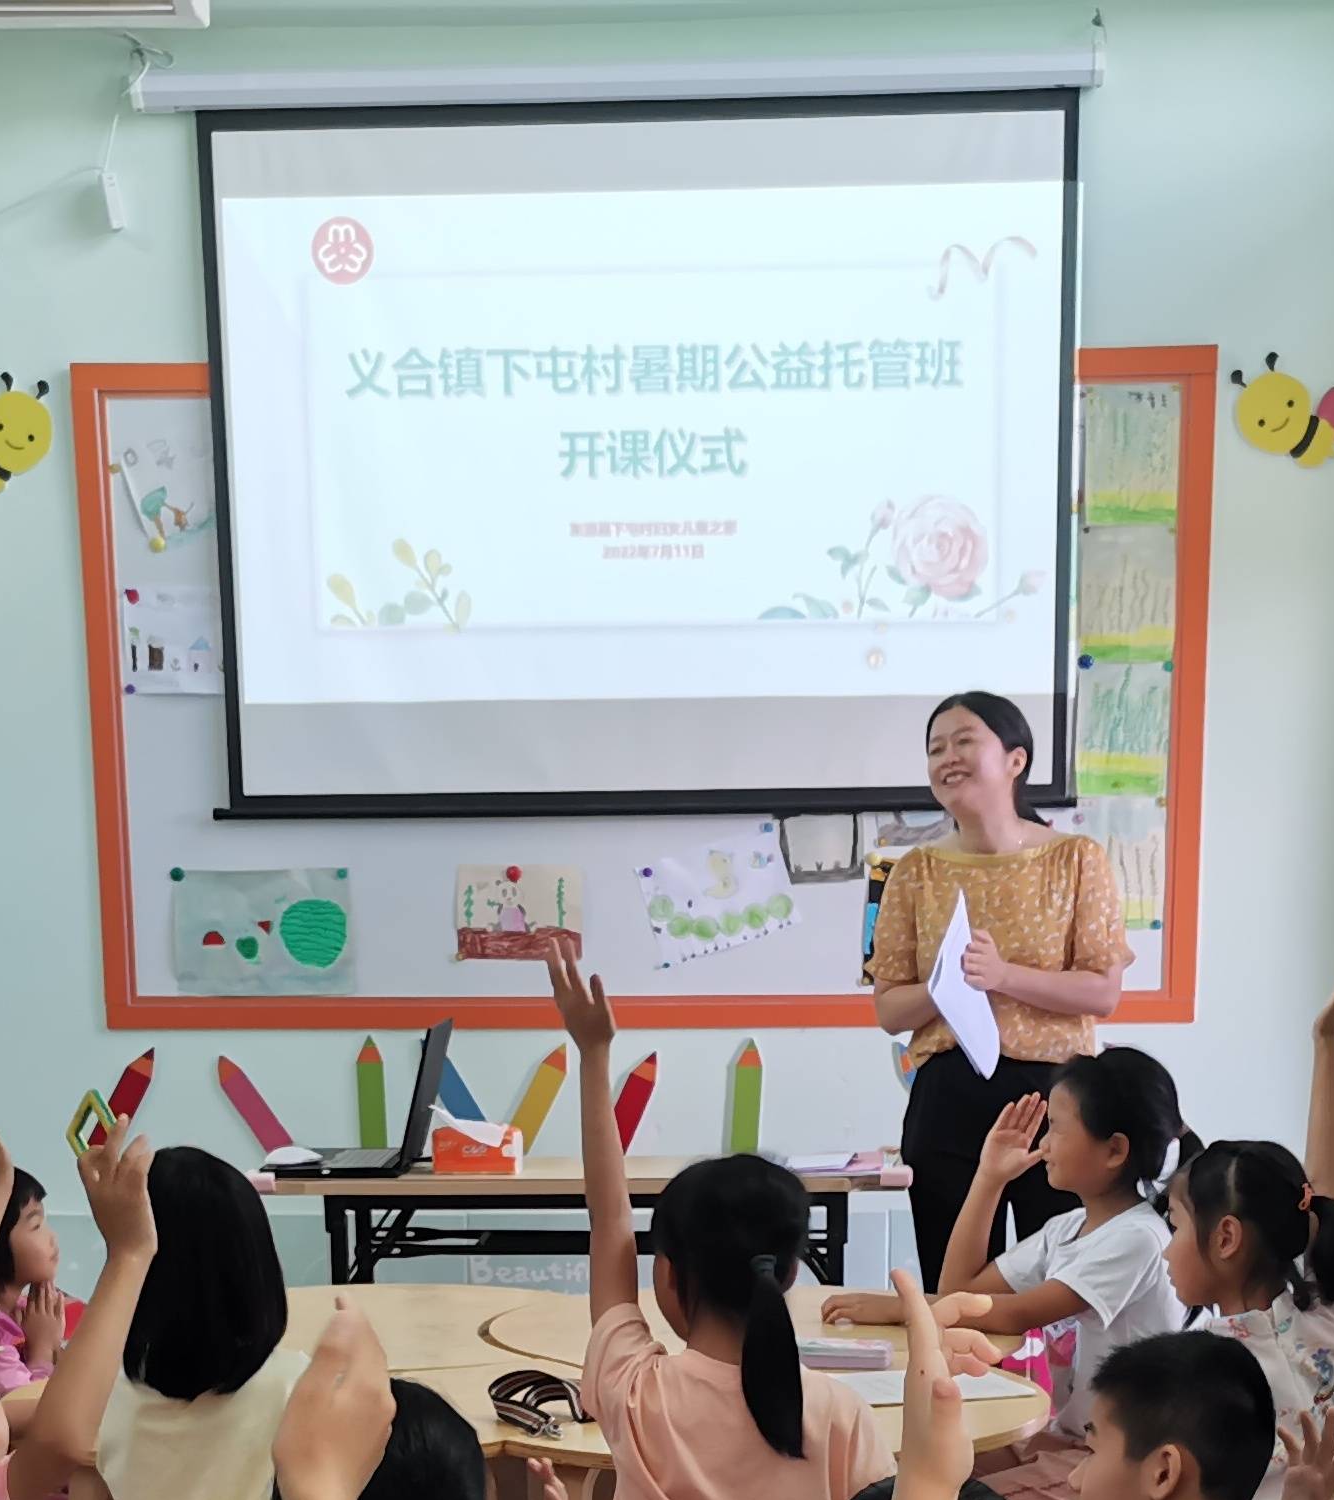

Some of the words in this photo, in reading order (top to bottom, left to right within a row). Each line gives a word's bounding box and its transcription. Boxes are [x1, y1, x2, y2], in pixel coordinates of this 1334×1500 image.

[345, 338, 965, 400] 义合镇下屯村暑期公益托管班
[558, 427, 749, 480] 开课仪式
